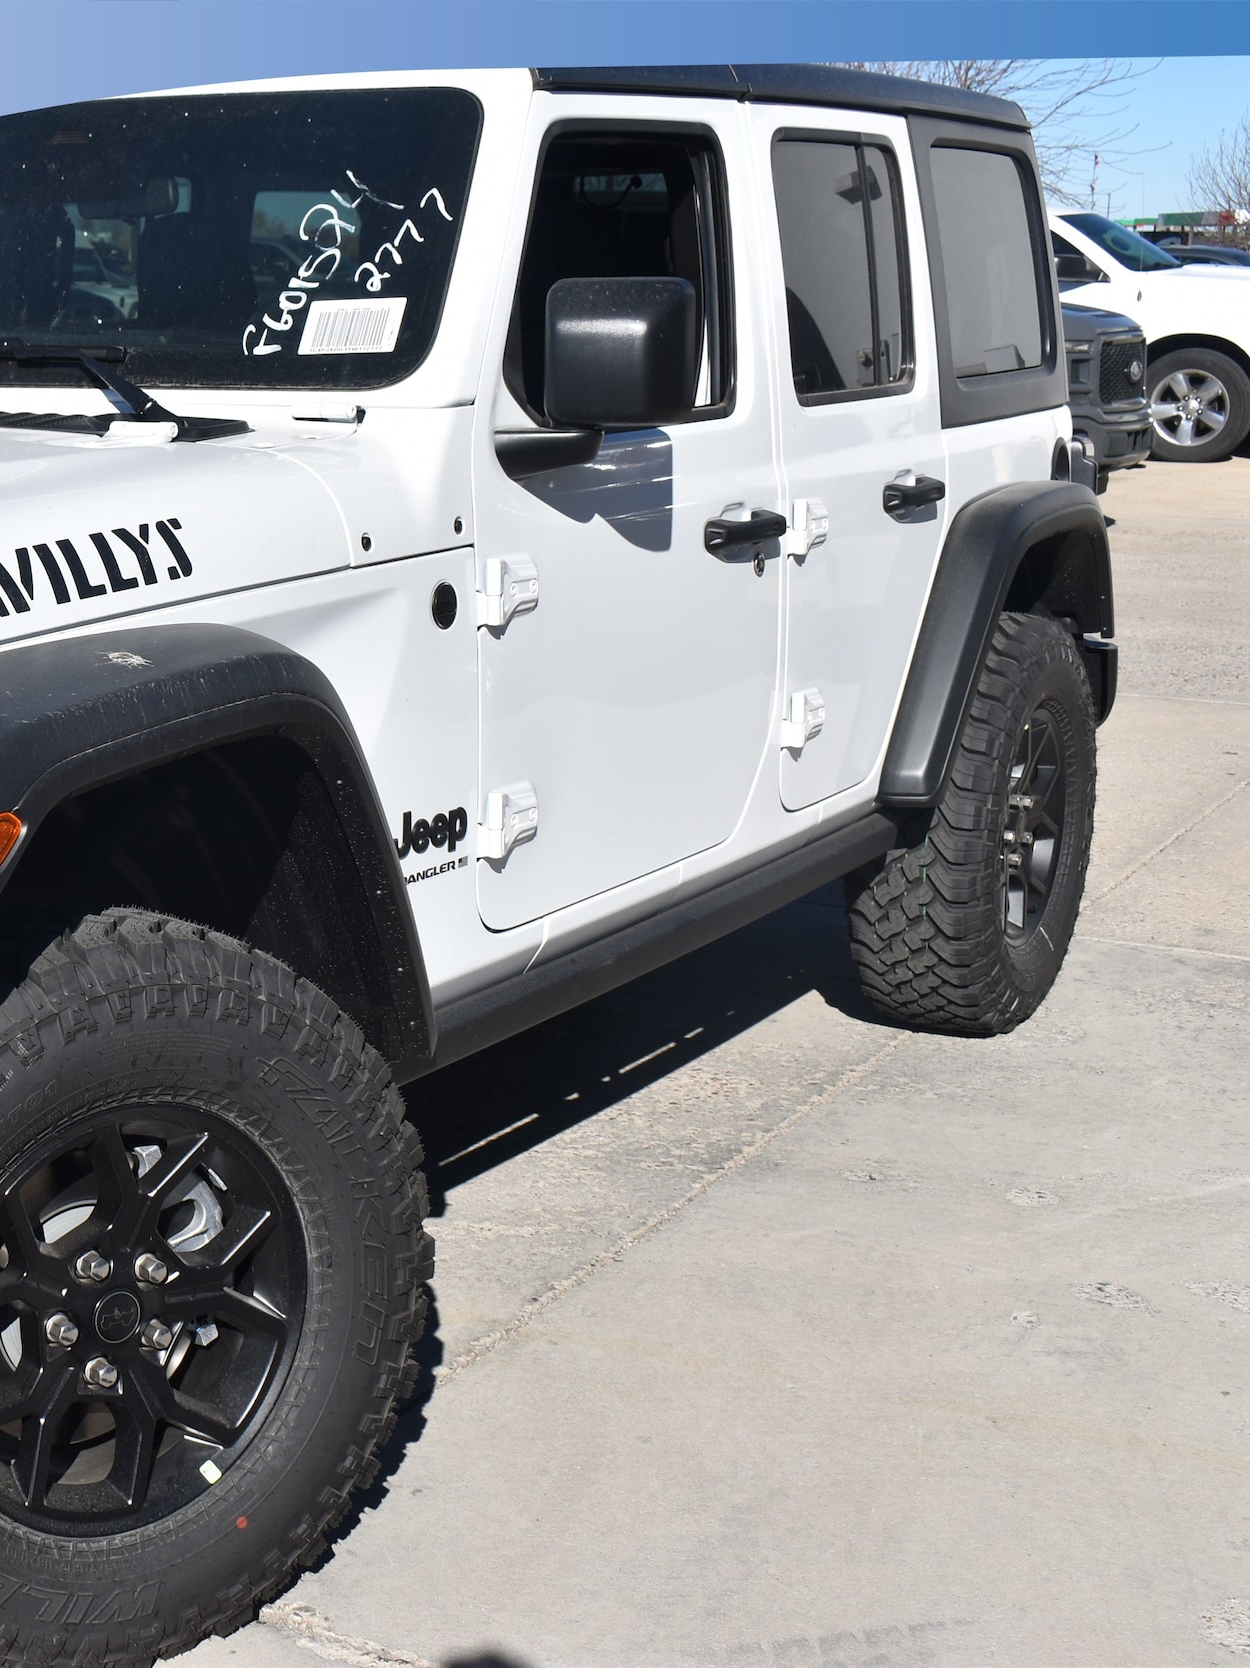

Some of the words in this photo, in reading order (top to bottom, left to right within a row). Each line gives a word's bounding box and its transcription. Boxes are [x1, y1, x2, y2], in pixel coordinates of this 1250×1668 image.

[354, 187, 453, 292] 2777
[393, 806, 468, 860] Jeep
[404, 860, 456, 886] ANGLER
